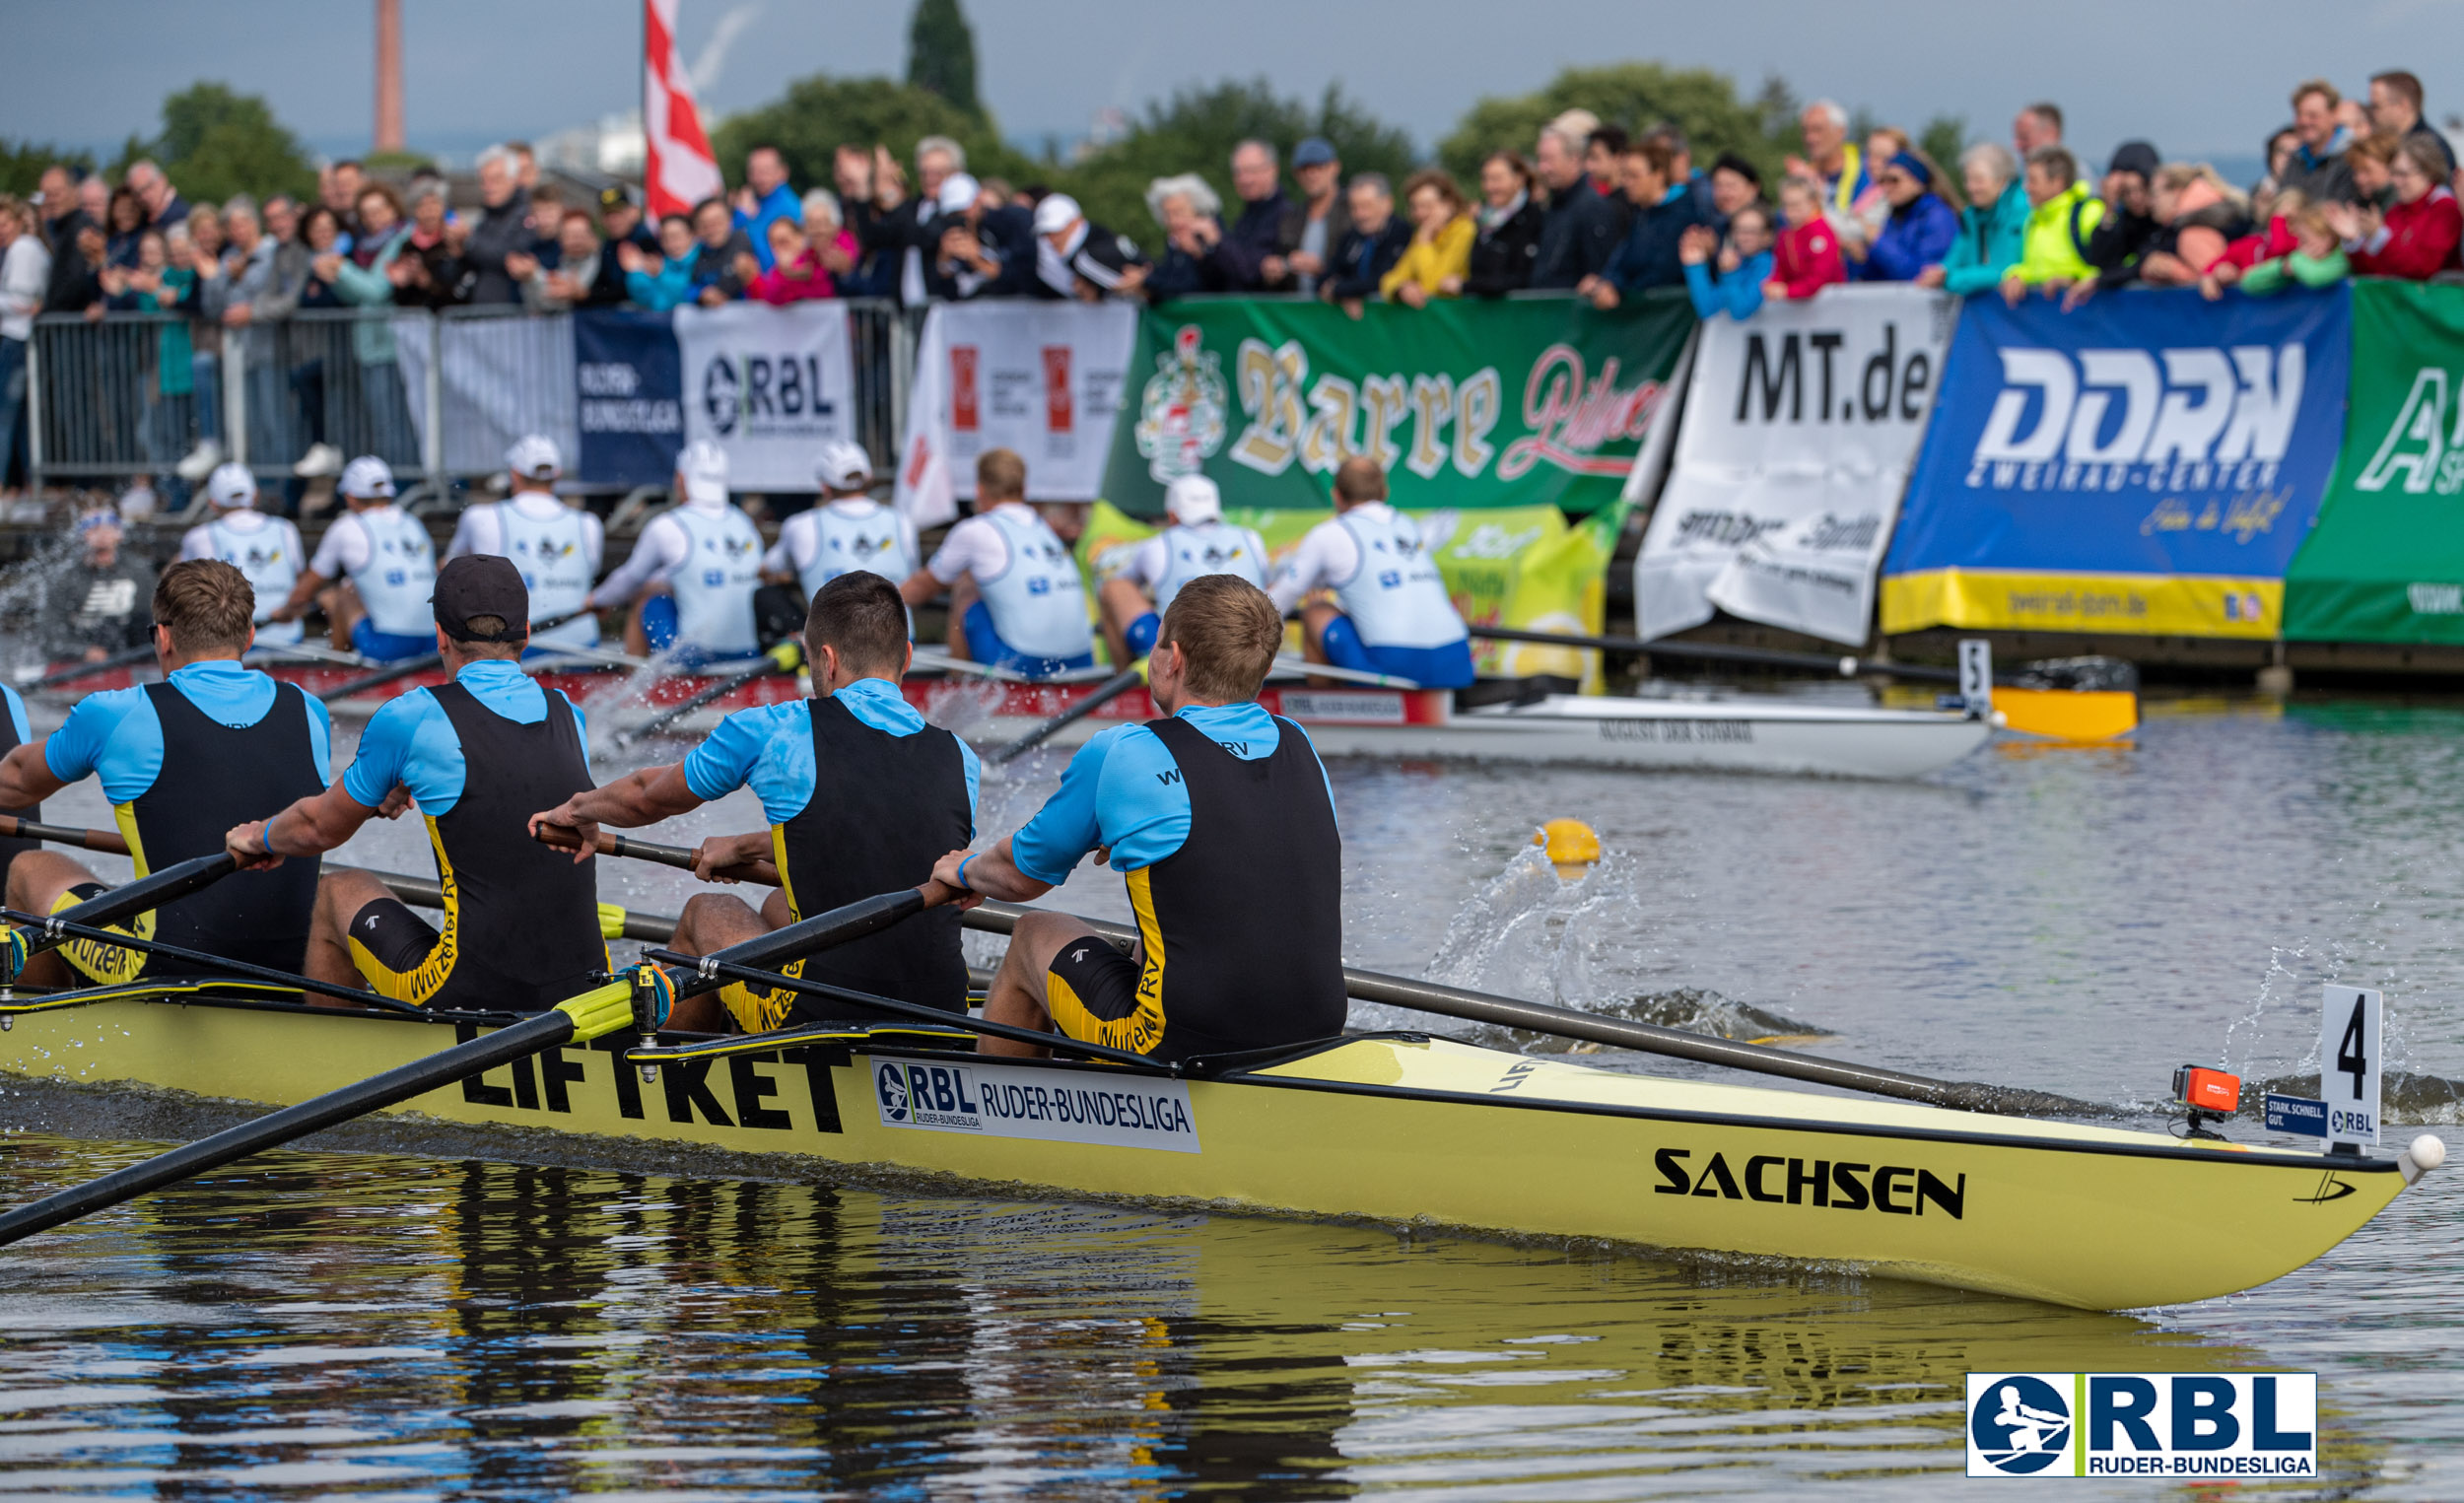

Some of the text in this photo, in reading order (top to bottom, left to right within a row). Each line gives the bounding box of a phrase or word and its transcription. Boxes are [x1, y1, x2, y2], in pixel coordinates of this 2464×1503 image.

[749, 354, 834, 417] RBL
[1735, 319, 1931, 424] MT.de
[1971, 342, 2307, 464] DORN
[1228, 336, 1502, 480] Barre
[1964, 459, 2281, 493] ZWEIRAD-CENTER
[453, 1025, 854, 1134] LIFTKET
[2337, 993, 2366, 1101] 4
[907, 1065, 1192, 1133] RBL RUDER-BUNDESLIGA
[916, 1112, 981, 1128] RUDER-BUNDESLIGA
[2268, 1100, 2324, 1119] STARK. SCHNELL.
[2268, 1115, 2285, 1127] GUT.
[2346, 1112, 2373, 1132] RBL
[1654, 1147, 1966, 1220] SACHSEN
